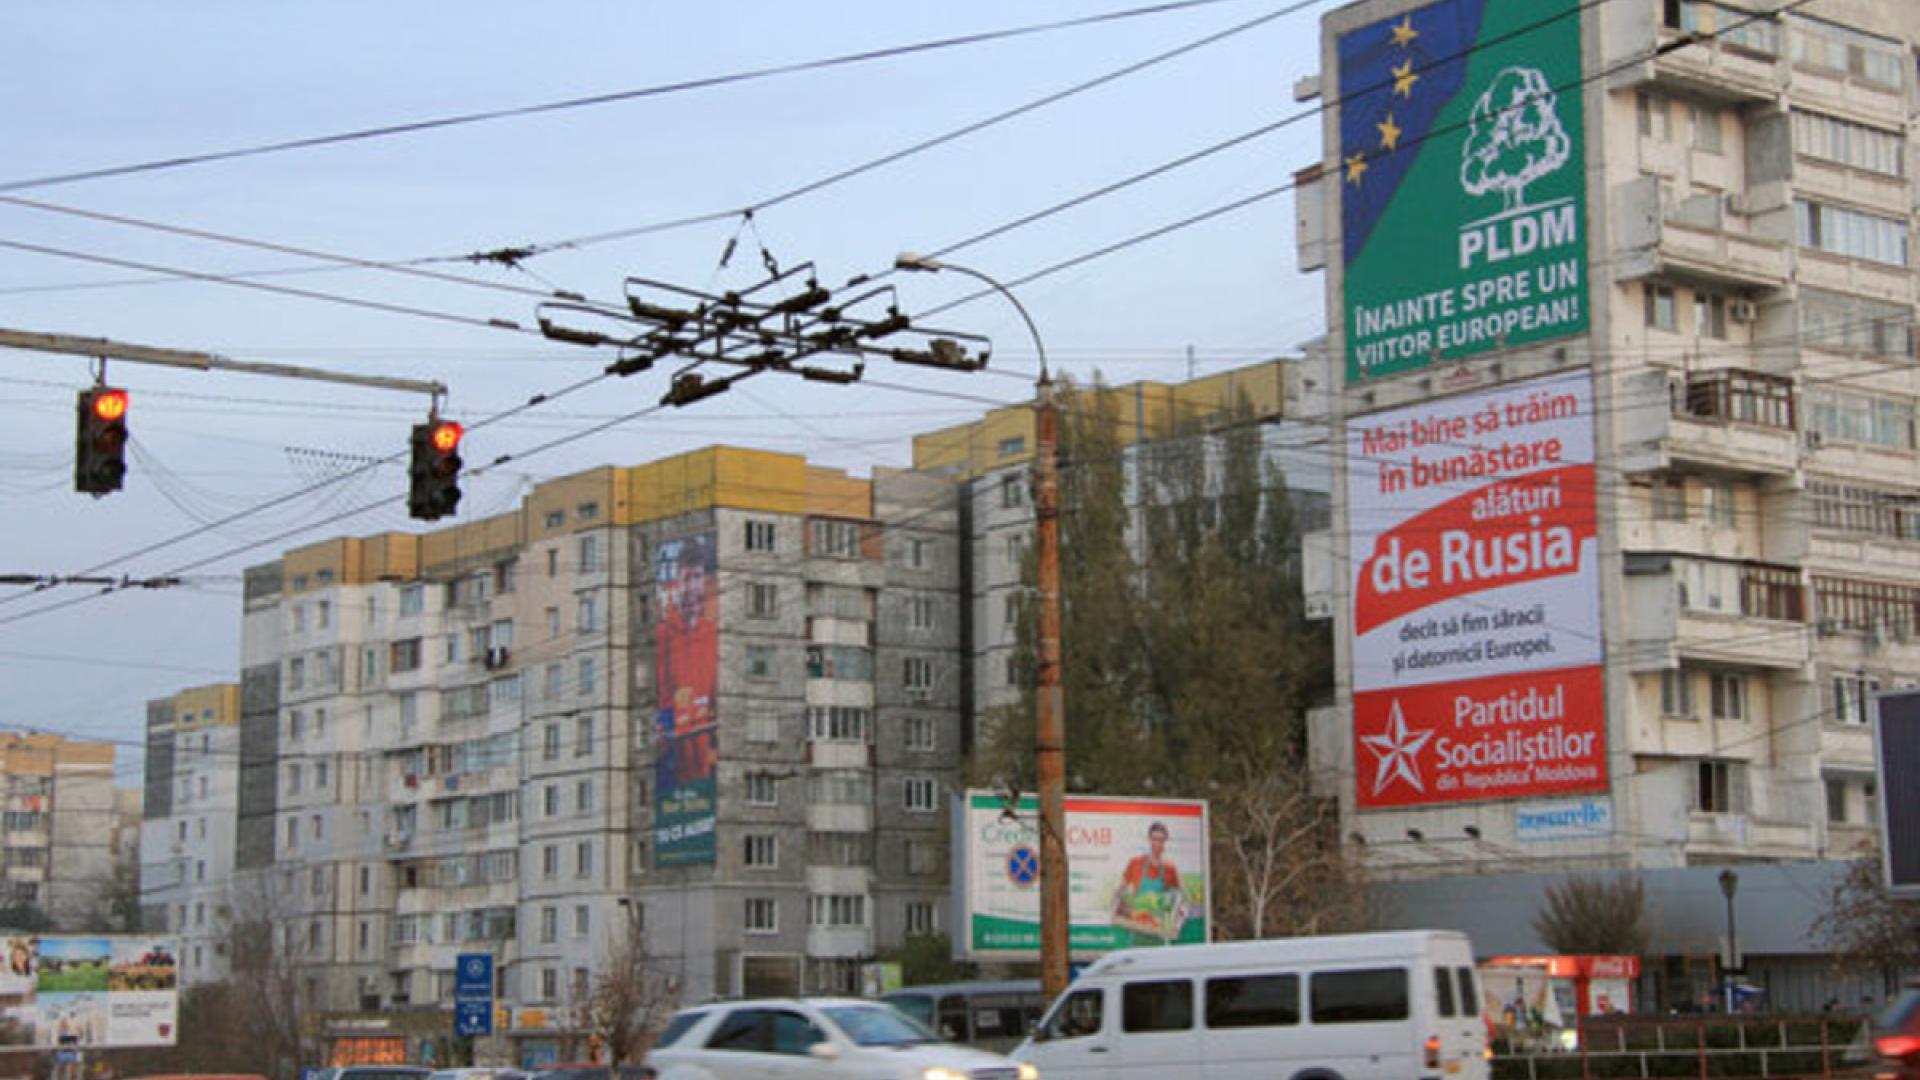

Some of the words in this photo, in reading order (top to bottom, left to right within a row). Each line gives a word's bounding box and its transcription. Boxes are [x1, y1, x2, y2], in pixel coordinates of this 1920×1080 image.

[1459, 206, 1577, 269] PLDM
[1355, 288, 1456, 339] ÎNAINTE
[1461, 271, 1531, 311] SPRE
[1538, 257, 1578, 294] UN
[1356, 330, 1432, 367] VIITOR
[1437, 295, 1579, 349] EUROPEAN!
[1362, 424, 1407, 456] Mai
[1411, 415, 1467, 447] bine
[1472, 403, 1500, 436] să
[1506, 390, 1578, 428] trăim
[1411, 437, 1562, 488] bunăstare
[1470, 475, 1561, 521] alături
[1371, 538, 1431, 594] de
[1440, 515, 1575, 584] Rusia
[1462, 612, 1489, 633] fim
[1408, 641, 1483, 669] datornicii
[1454, 684, 1565, 728] Partidul
[1435, 725, 1596, 772] Socialiștilor
